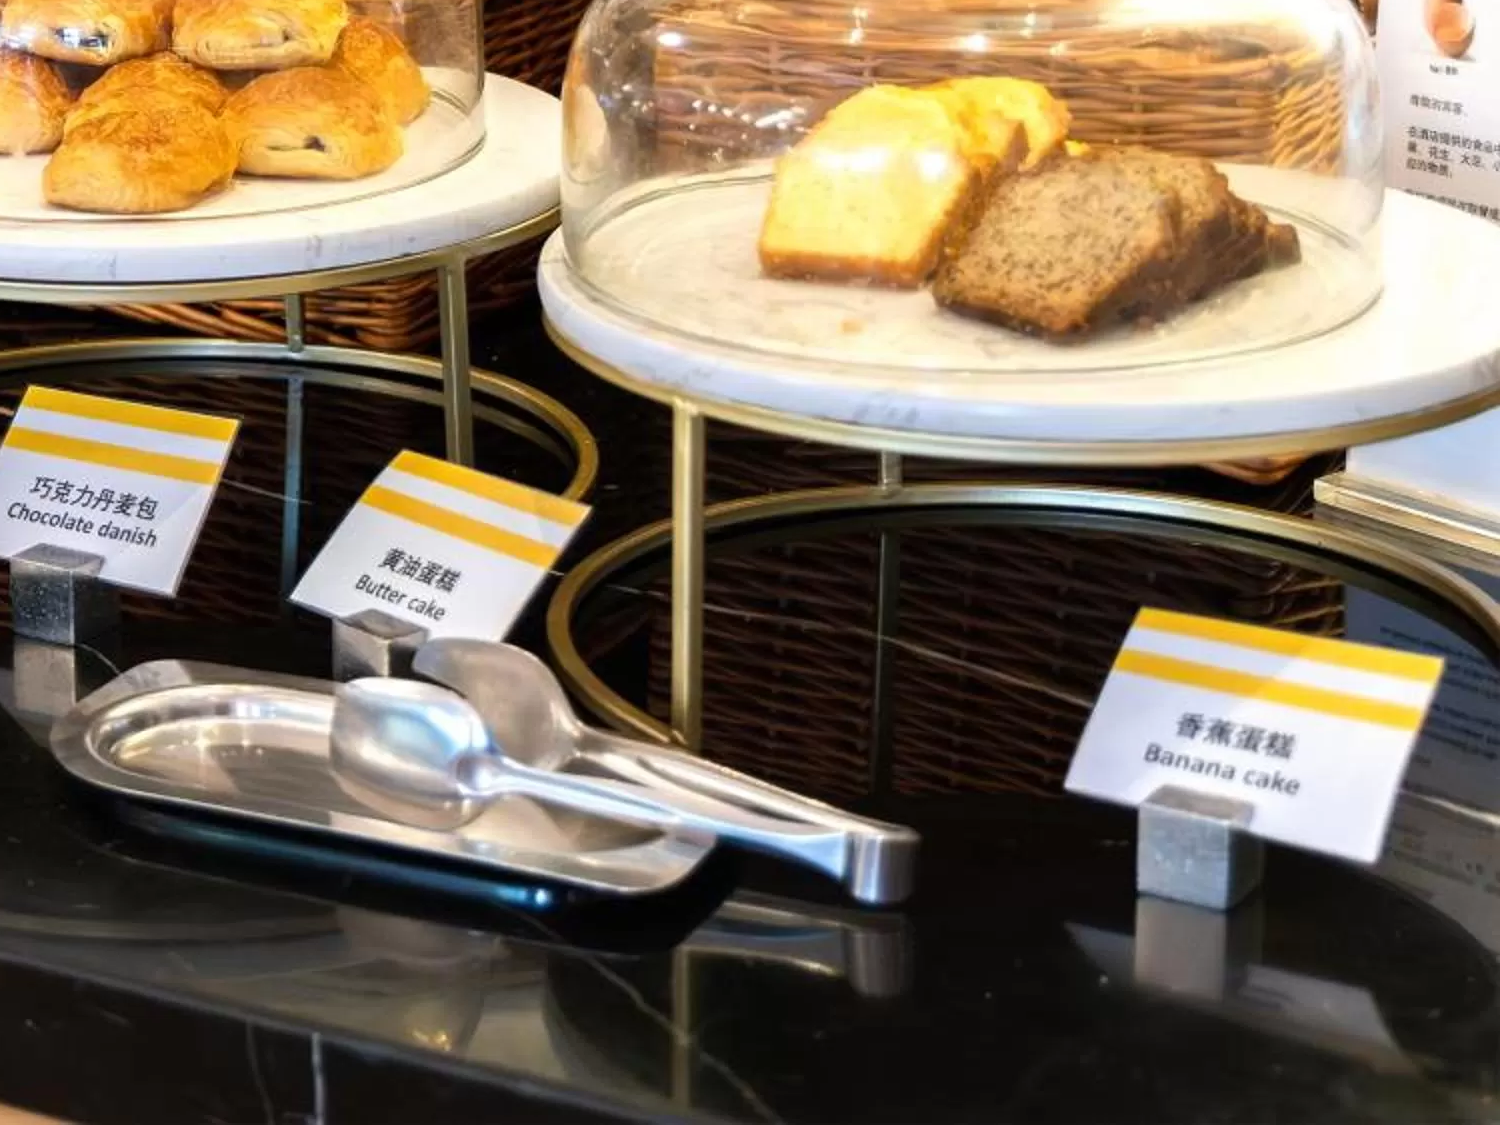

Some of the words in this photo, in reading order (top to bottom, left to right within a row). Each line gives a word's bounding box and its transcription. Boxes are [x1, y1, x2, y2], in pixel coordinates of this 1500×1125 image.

[29, 475, 159, 521] 巧克力丹麦包
[7, 501, 94, 535] Chocolate
[97, 519, 157, 547] danish
[378, 546, 462, 593] 黄油蛋糕
[355, 573, 406, 605] Butter
[407, 596, 447, 622] cake
[1176, 711, 1297, 761] 香蕉蛋糕
[1143, 741, 1237, 782] Banana
[1243, 767, 1302, 797] cake
